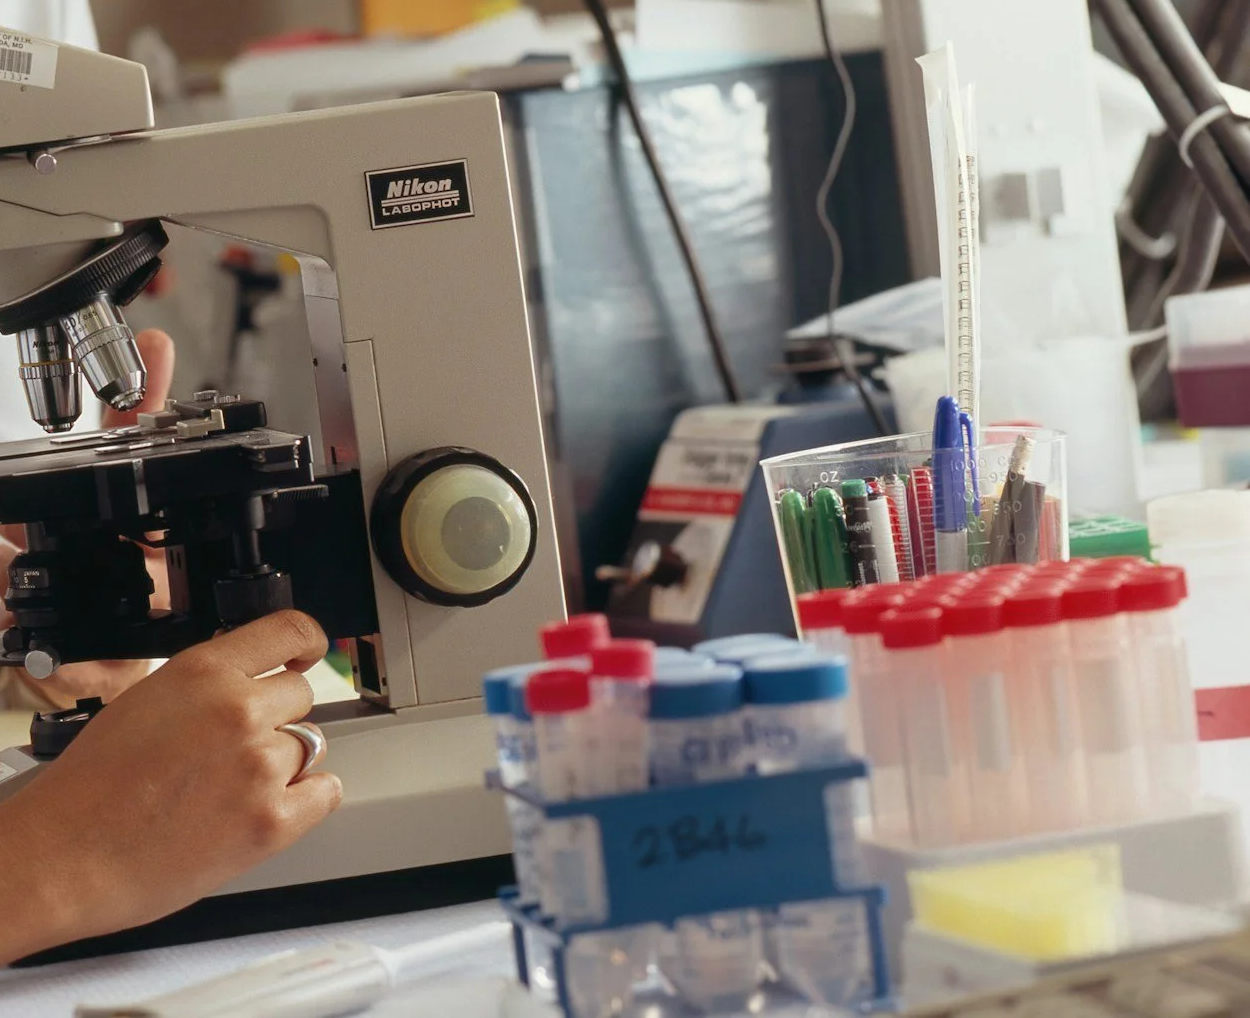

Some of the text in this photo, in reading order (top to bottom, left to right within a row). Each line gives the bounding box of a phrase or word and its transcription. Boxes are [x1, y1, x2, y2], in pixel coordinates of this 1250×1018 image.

[386, 177, 452, 199] Nikon
[382, 197, 460, 216] LABOPHOT
[820, 470, 839, 483] OZ
